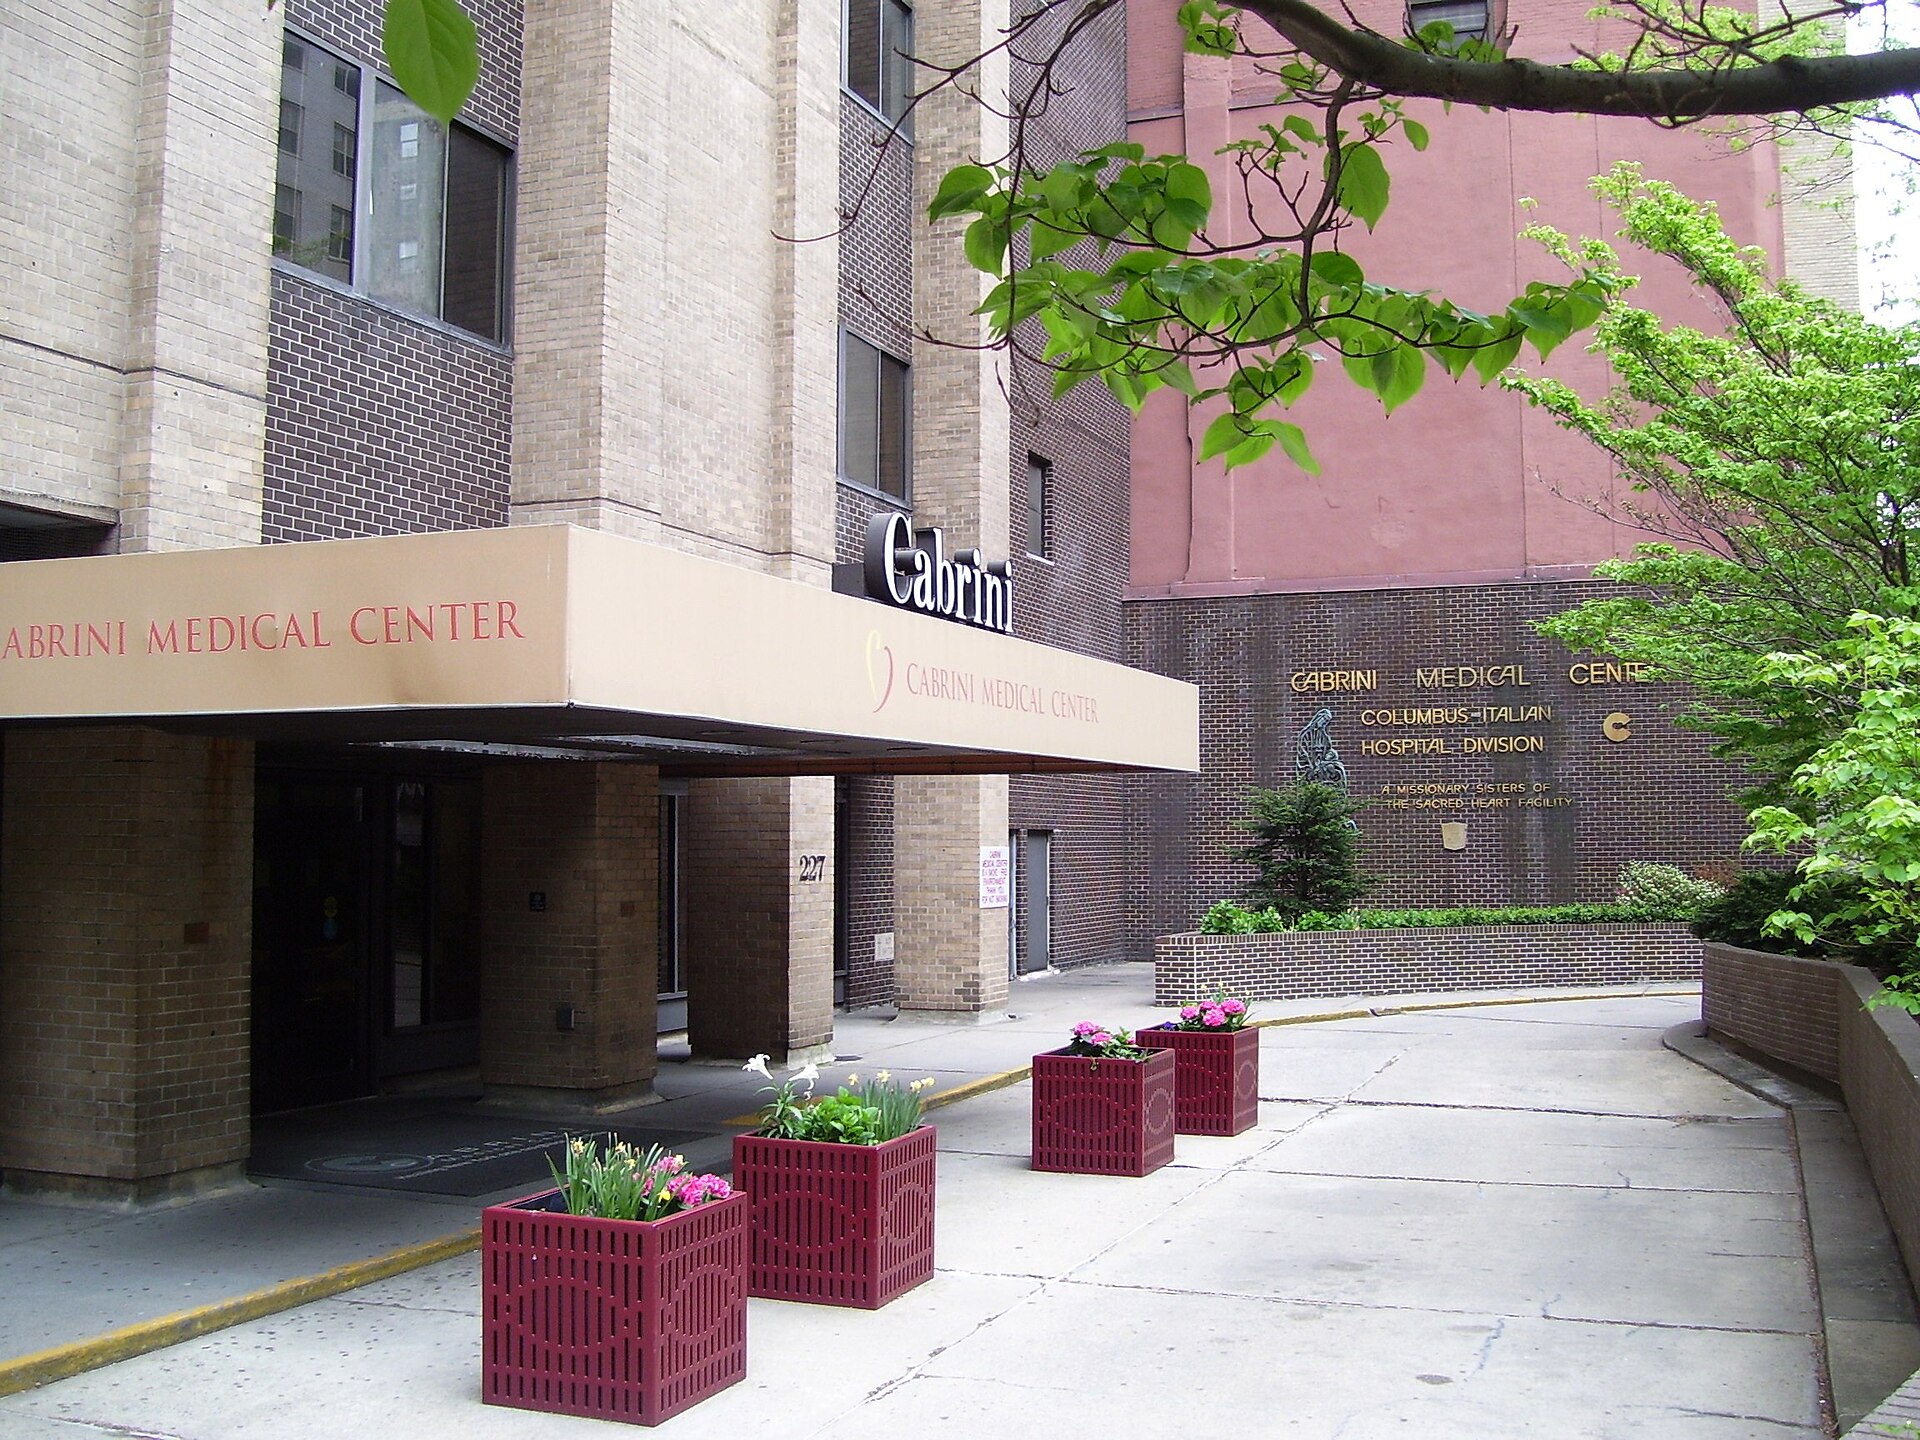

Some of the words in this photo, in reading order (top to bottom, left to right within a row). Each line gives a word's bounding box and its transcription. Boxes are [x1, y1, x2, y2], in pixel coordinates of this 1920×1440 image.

[884, 512, 1014, 634] Cabrini
[146, 609, 333, 654] MEDICAL
[349, 600, 525, 645] CENTER
[1291, 669, 1377, 693] CABRINI
[1416, 665, 1531, 689] MEDICAL
[1569, 662, 1650, 685] CENTE
[906, 662, 974, 704] CABRINI
[981, 680, 1045, 715] MEDICAL
[1051, 690, 1099, 723] CENTER
[1361, 708, 1468, 726] COLUMBUS
[1482, 705, 1552, 723] ITALIAN
[1361, 738, 1451, 756] HOSPITAL
[1464, 736, 1544, 754] DIVISION
[1381, 785, 1390, 795] A
[1397, 784, 1469, 795] MISSIONARY
[1476, 783, 1526, 793] SISTERS
[1533, 782, 1551, 793] OF
[1388, 799, 1409, 809] THE
[1415, 799, 1464, 809] SACRED
[1471, 798, 1511, 809] HEART
[799, 855, 826, 882] 227
